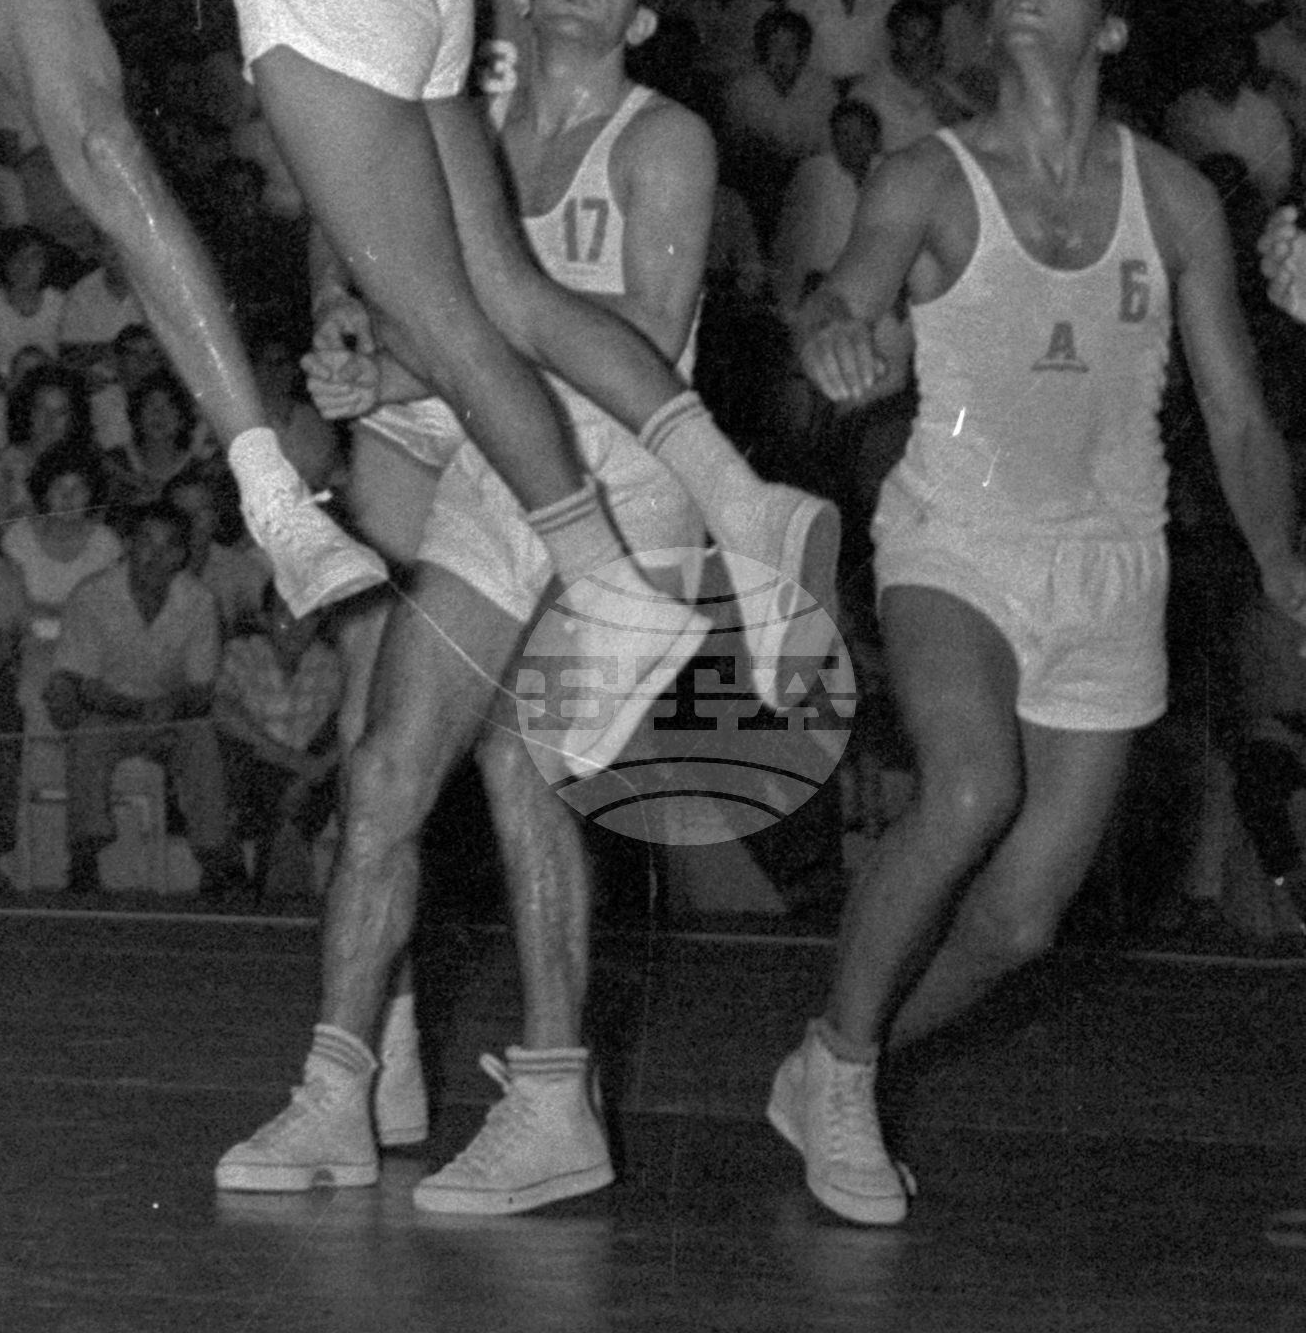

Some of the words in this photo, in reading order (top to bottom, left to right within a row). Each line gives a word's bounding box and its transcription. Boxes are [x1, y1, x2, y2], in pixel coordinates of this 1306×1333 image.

[484, 39, 518, 93] 3
[562, 197, 610, 263] 17
[1119, 259, 1150, 323] 6
